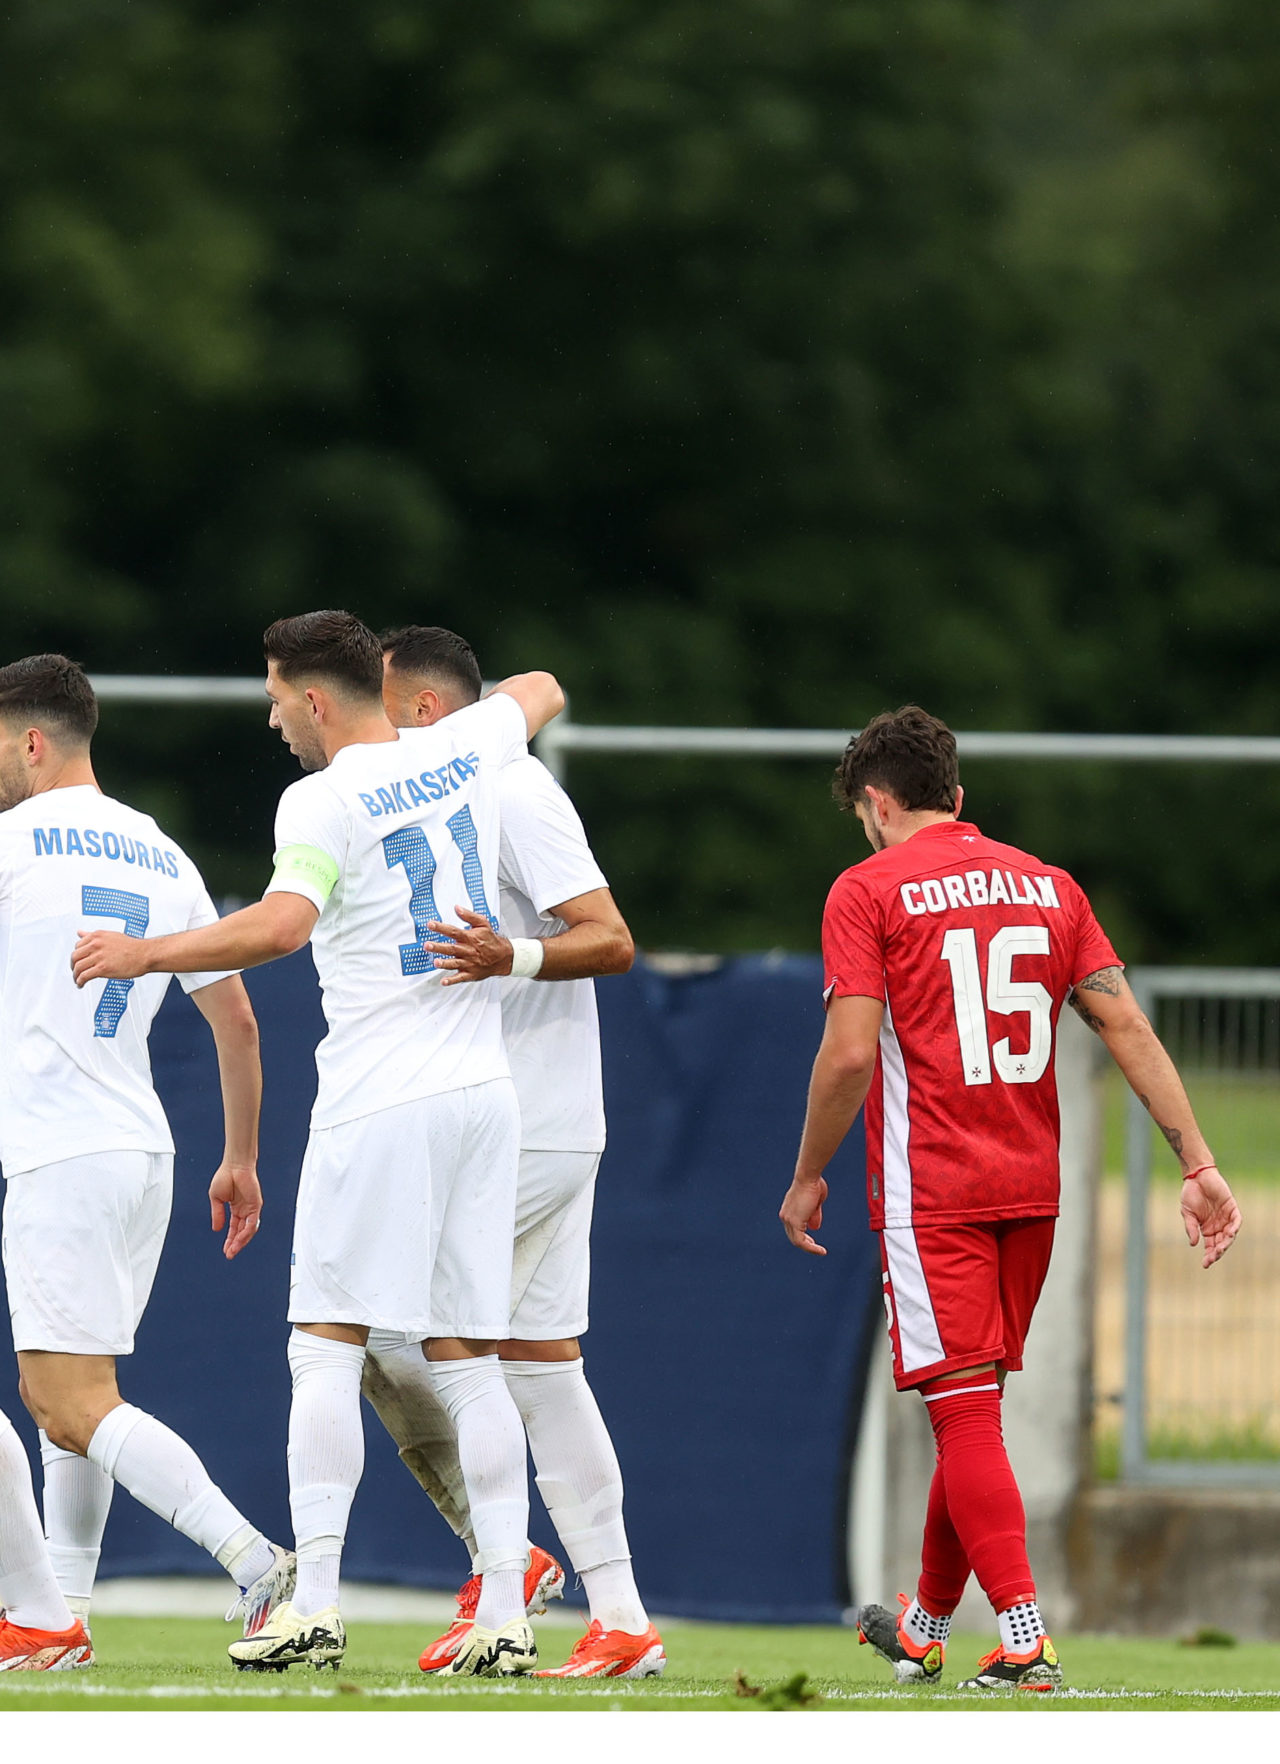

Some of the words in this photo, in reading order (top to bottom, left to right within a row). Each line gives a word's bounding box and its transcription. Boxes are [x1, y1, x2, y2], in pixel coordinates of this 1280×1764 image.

[33, 828, 179, 879] MASOURAS
[382, 803, 500, 976] 11
[900, 868, 1061, 915] CORBALAN
[82, 885, 150, 1038] 7
[940, 926, 1054, 1087] 15
